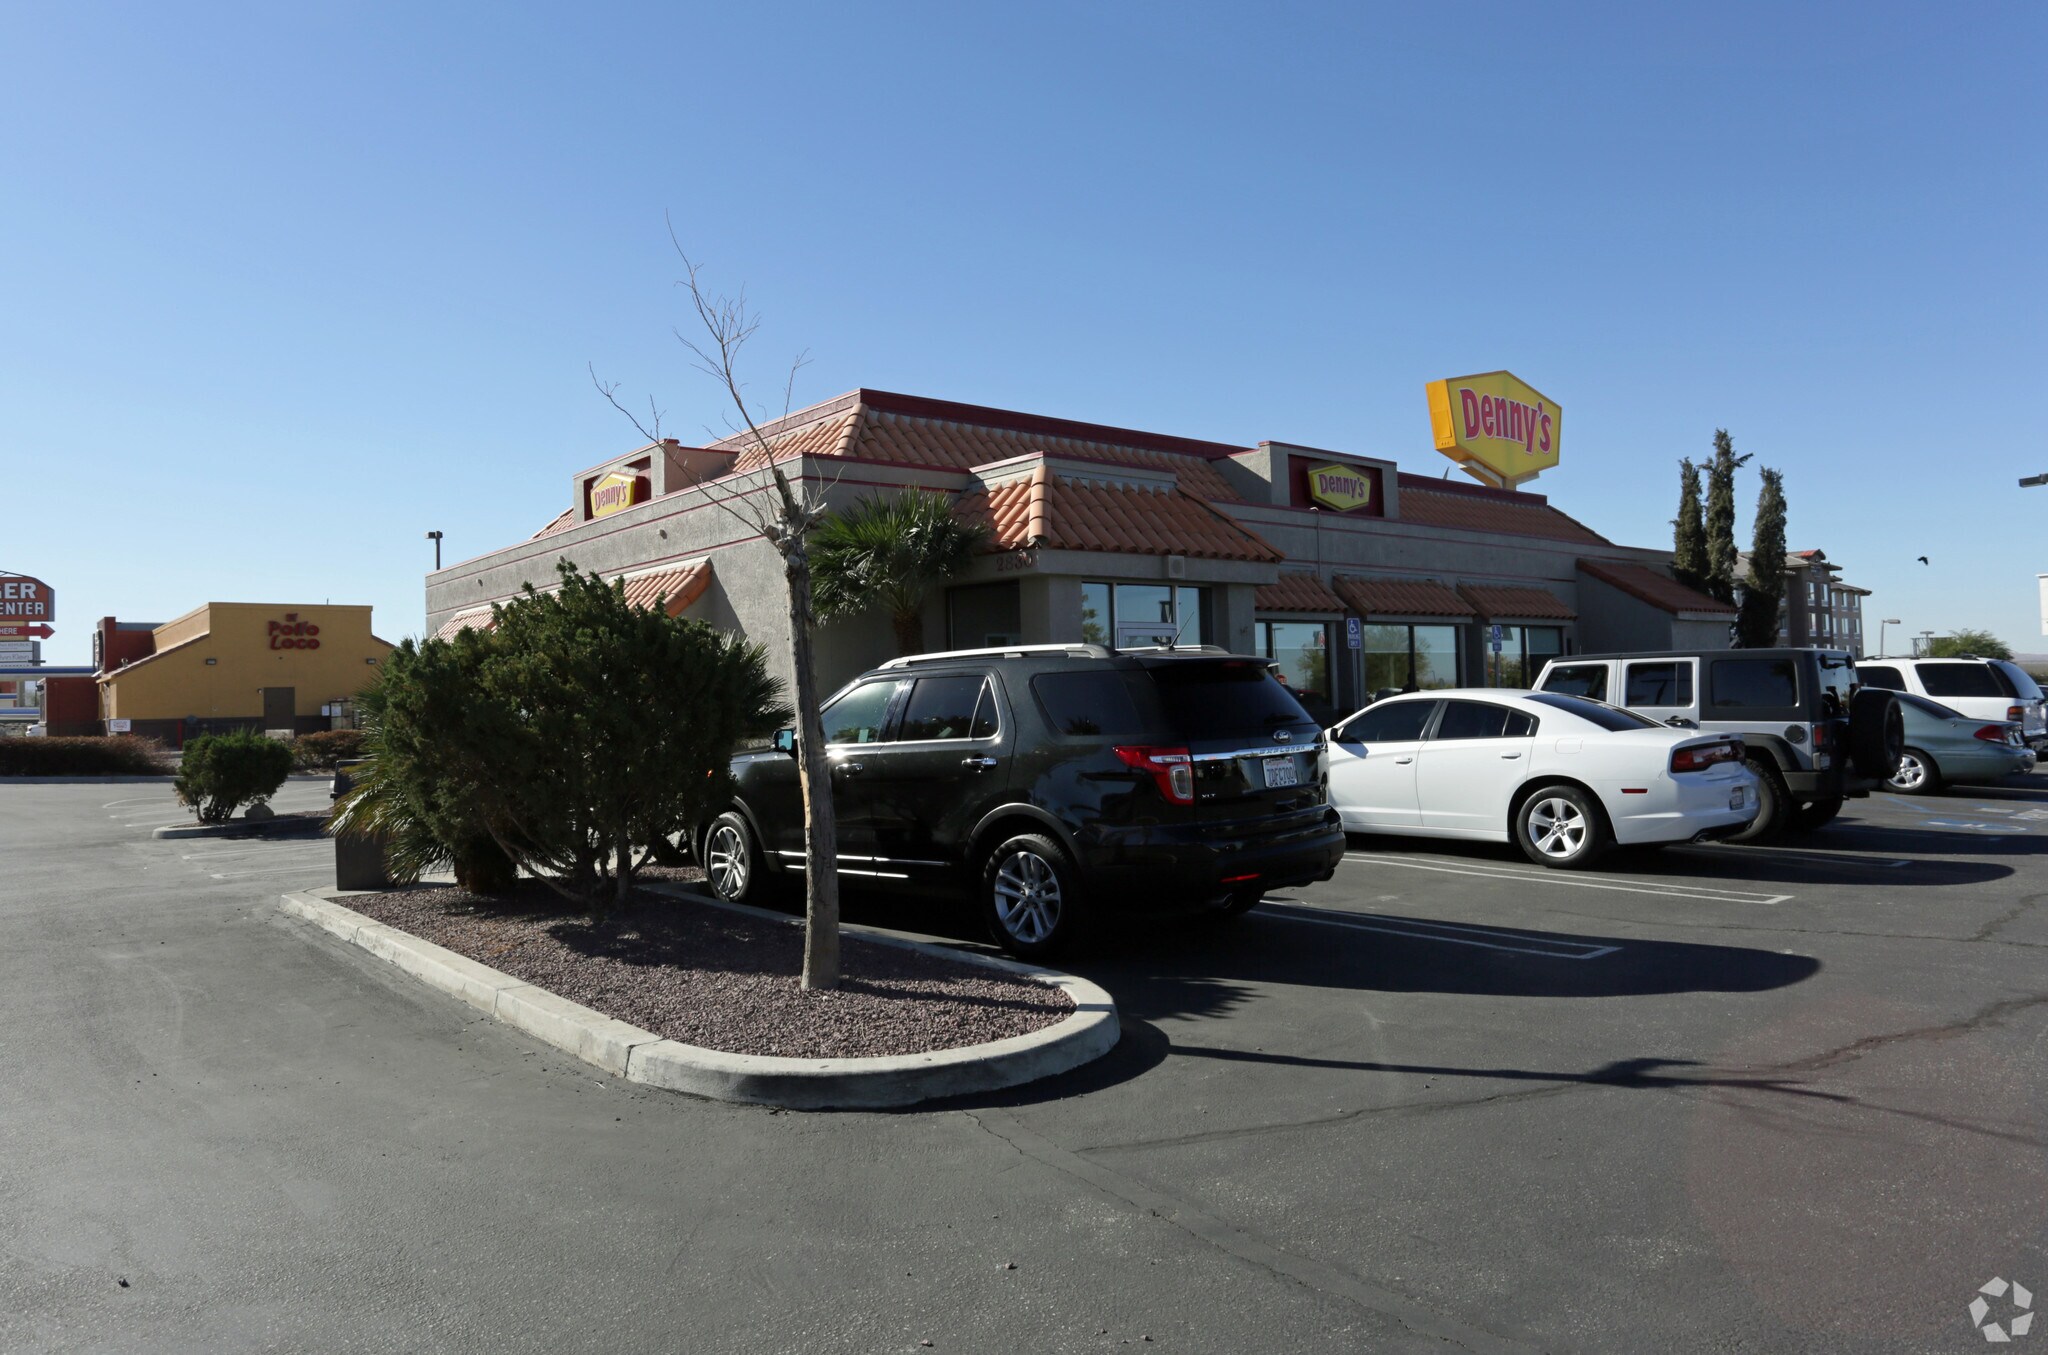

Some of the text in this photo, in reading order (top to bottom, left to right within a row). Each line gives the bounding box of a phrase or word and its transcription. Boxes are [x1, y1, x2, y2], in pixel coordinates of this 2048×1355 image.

[1459, 388, 1551, 454] Denny's
[594, 481, 627, 511] Denny's
[1318, 473, 1365, 498] Denny's
[268, 620, 320, 637] Pollo
[270, 634, 321, 651] Loco
